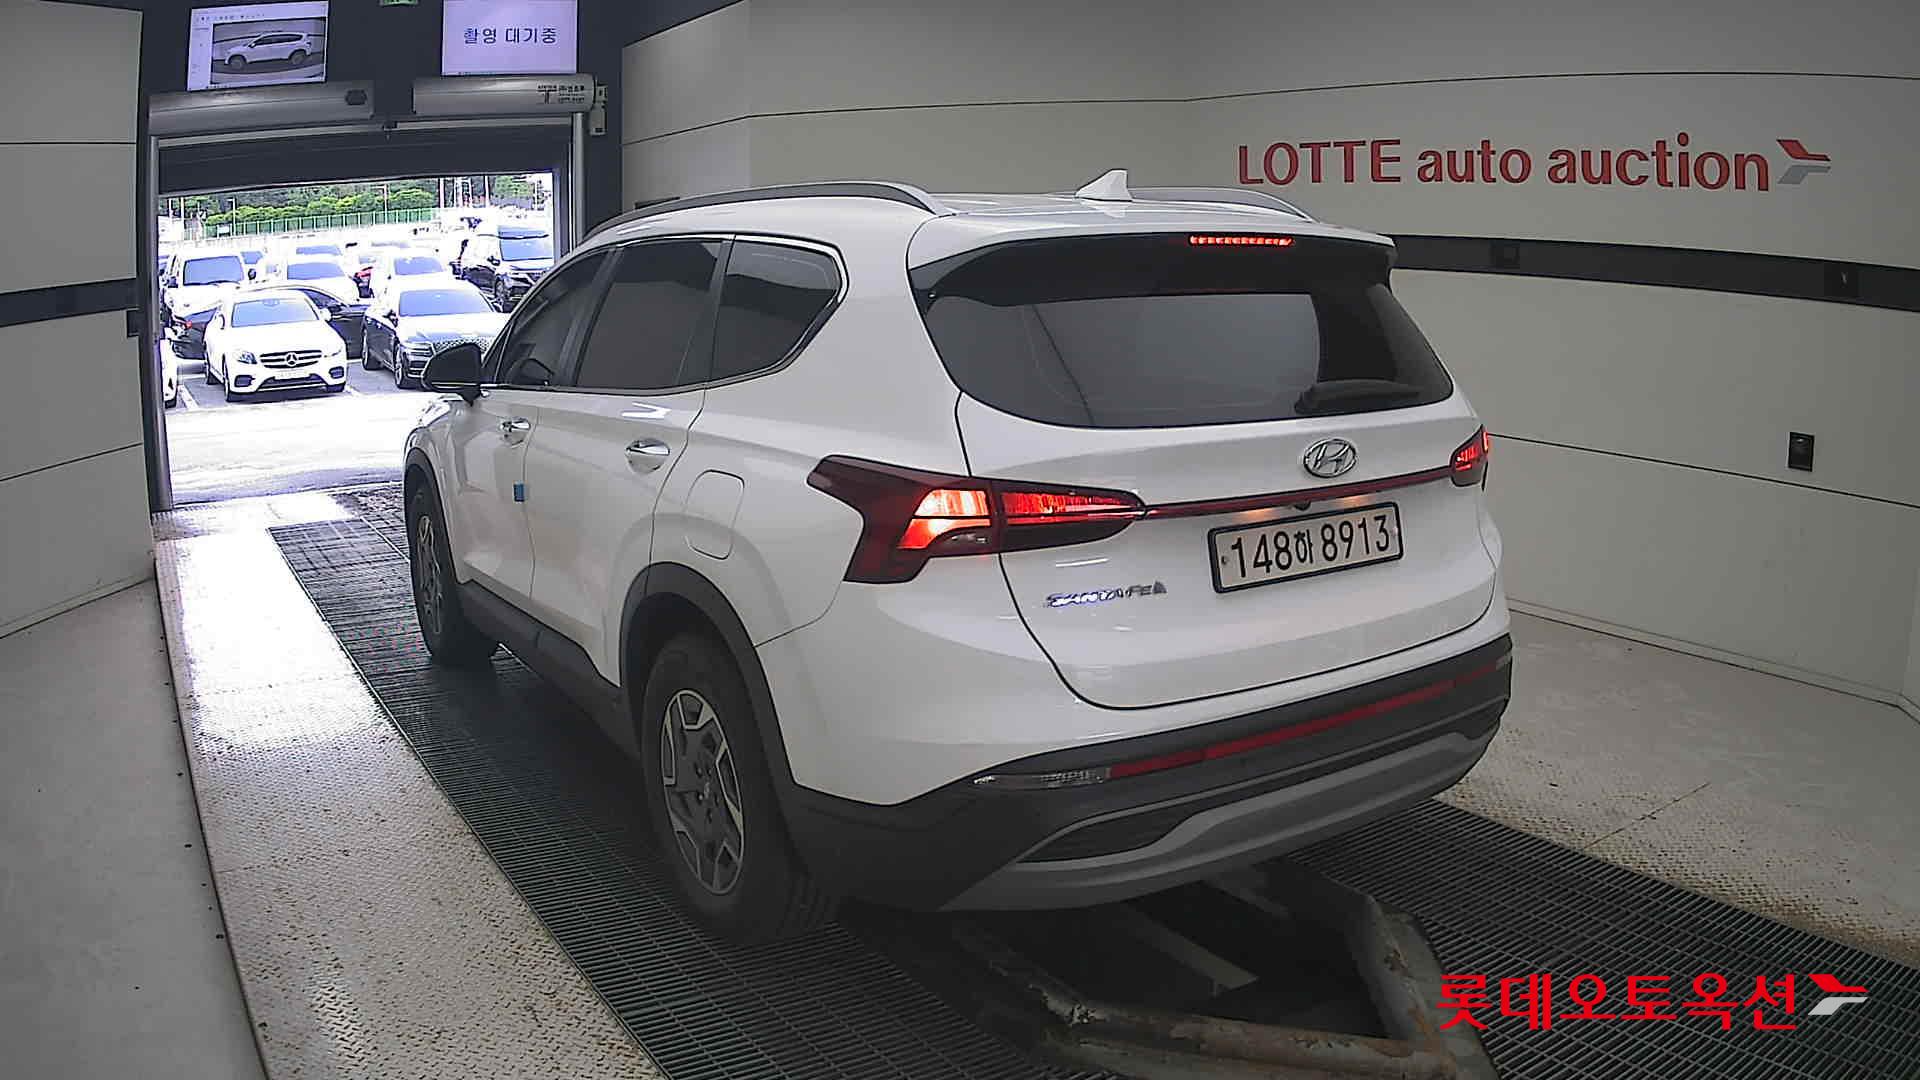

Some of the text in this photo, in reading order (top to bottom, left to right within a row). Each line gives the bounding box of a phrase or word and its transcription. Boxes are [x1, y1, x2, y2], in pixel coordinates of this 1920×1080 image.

[464, 28, 557, 44] 촬영 대기중
[1238, 132, 1769, 192] LOTTE auto auction
